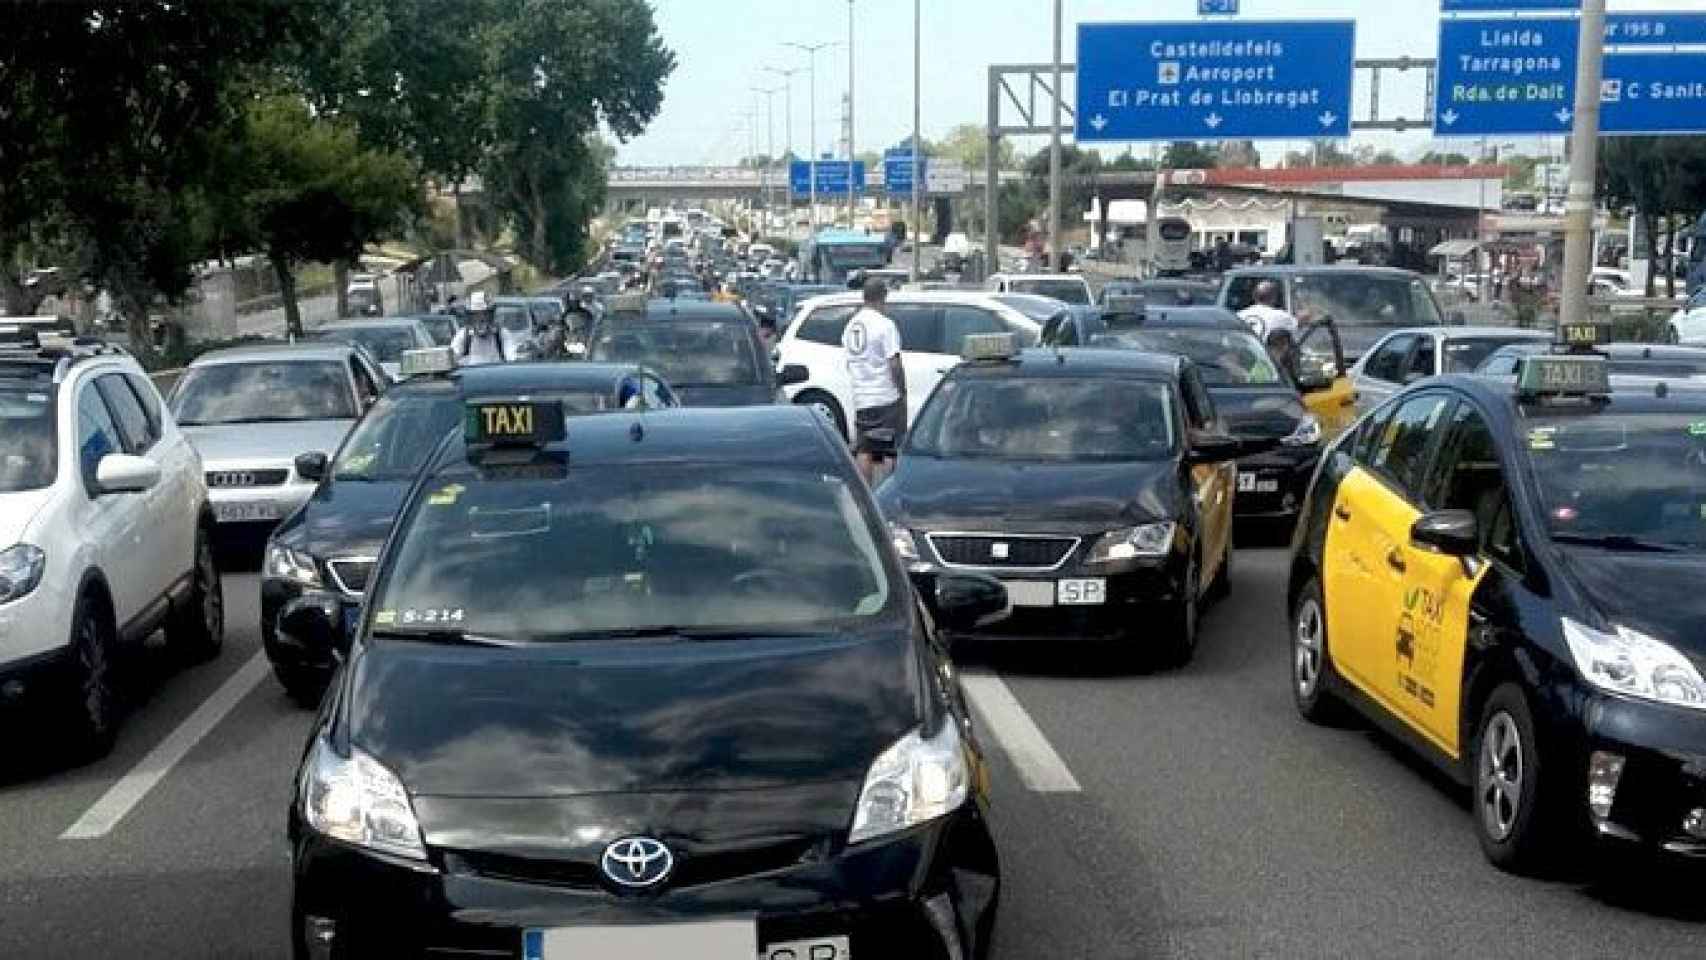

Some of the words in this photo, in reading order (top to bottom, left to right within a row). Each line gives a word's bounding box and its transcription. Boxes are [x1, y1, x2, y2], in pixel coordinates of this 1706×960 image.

[1480, 29, 1543, 46] Lleida
[1150, 39, 1284, 58] Castelldefels
[1184, 63, 1275, 83] Aeroport
[1459, 55, 1561, 75] Tarragona
[1108, 90, 1127, 107] El
[1136, 88, 1180, 106] Prat
[1189, 88, 1213, 105] de
[1221, 87, 1319, 108] Llobregat
[1496, 84, 1518, 100] de
[1627, 82, 1640, 98] C
[1650, 82, 1706, 98] Sanit
[1566, 326, 1596, 341] TAXI
[1542, 362, 1582, 384] TAXI
[481, 407, 533, 434] TAXI
[1064, 581, 1101, 601] SP
